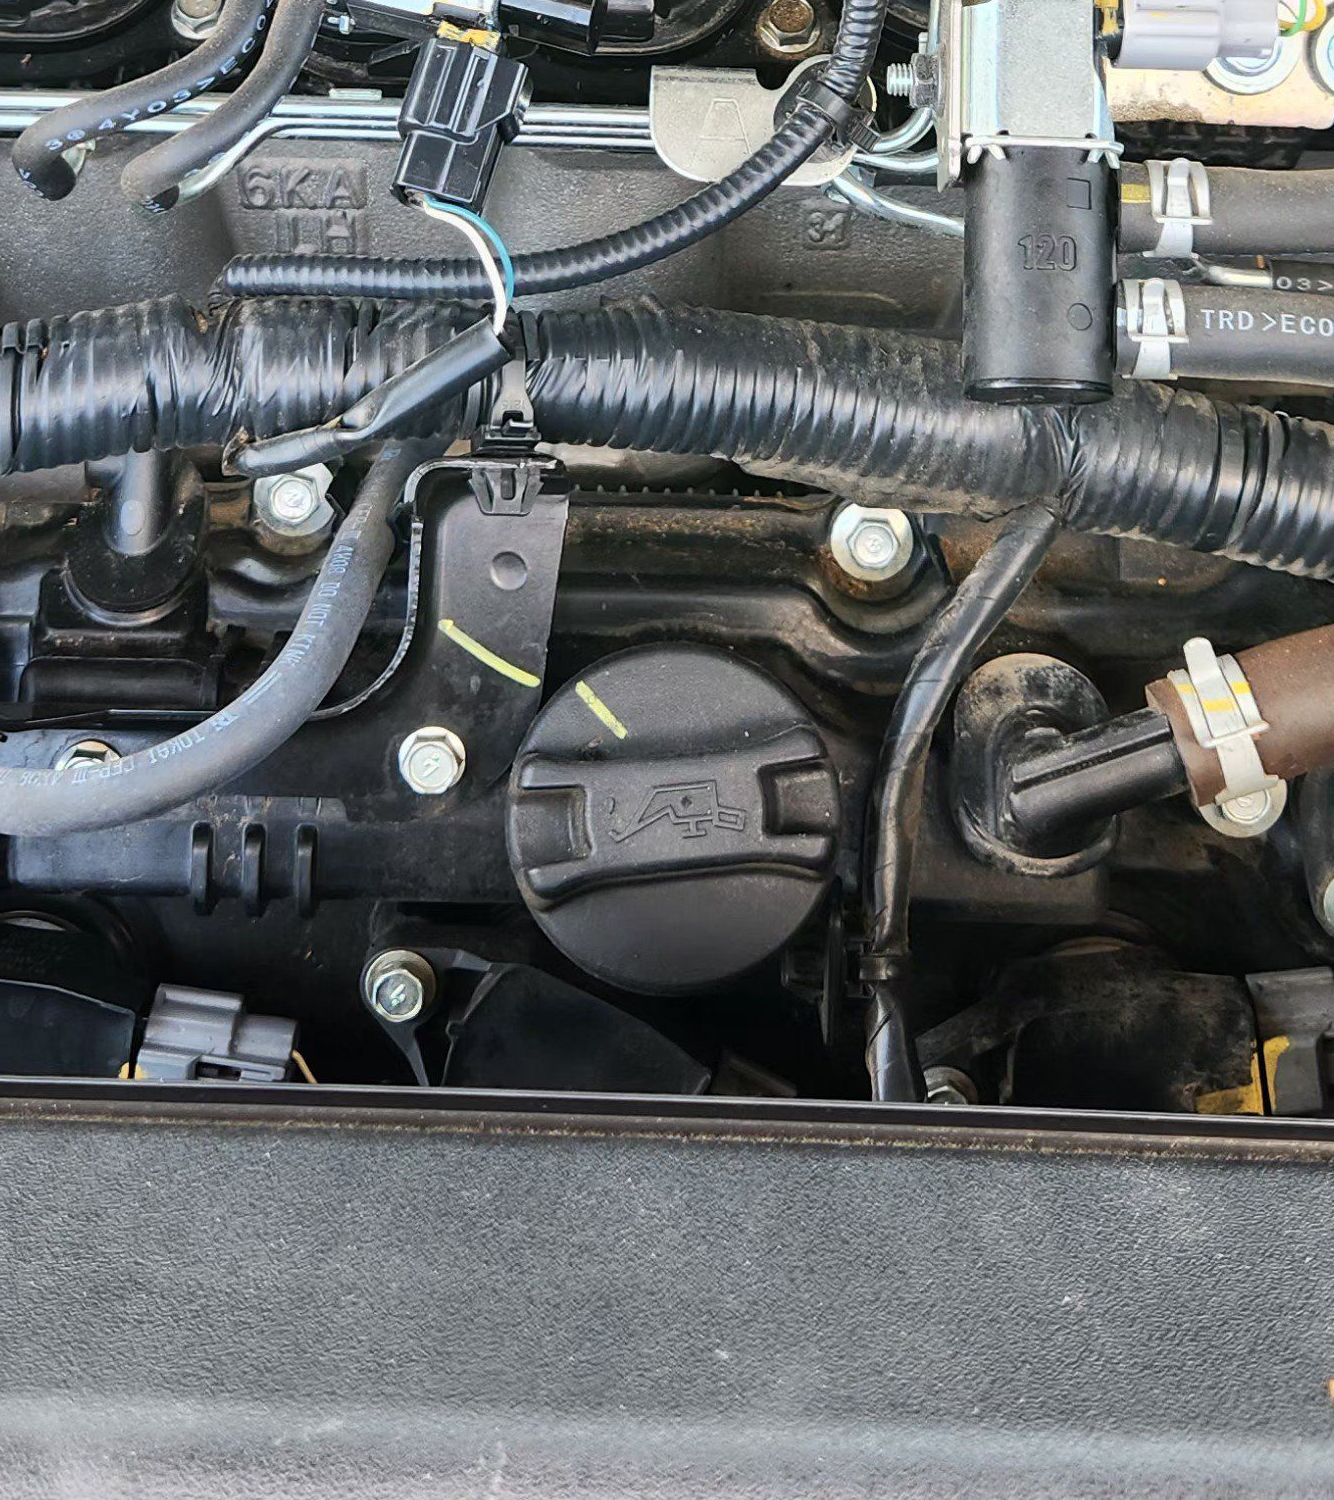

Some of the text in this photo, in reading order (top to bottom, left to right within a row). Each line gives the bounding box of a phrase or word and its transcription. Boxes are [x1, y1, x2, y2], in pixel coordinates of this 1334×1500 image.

[688, 97, 752, 169] A
[238, 164, 368, 210] 6KA
[1017, 234, 1077, 271] 120
[317, 581, 341, 598] DO
[307, 603, 332, 628] NOT
[149, 730, 206, 766] TOKAI
